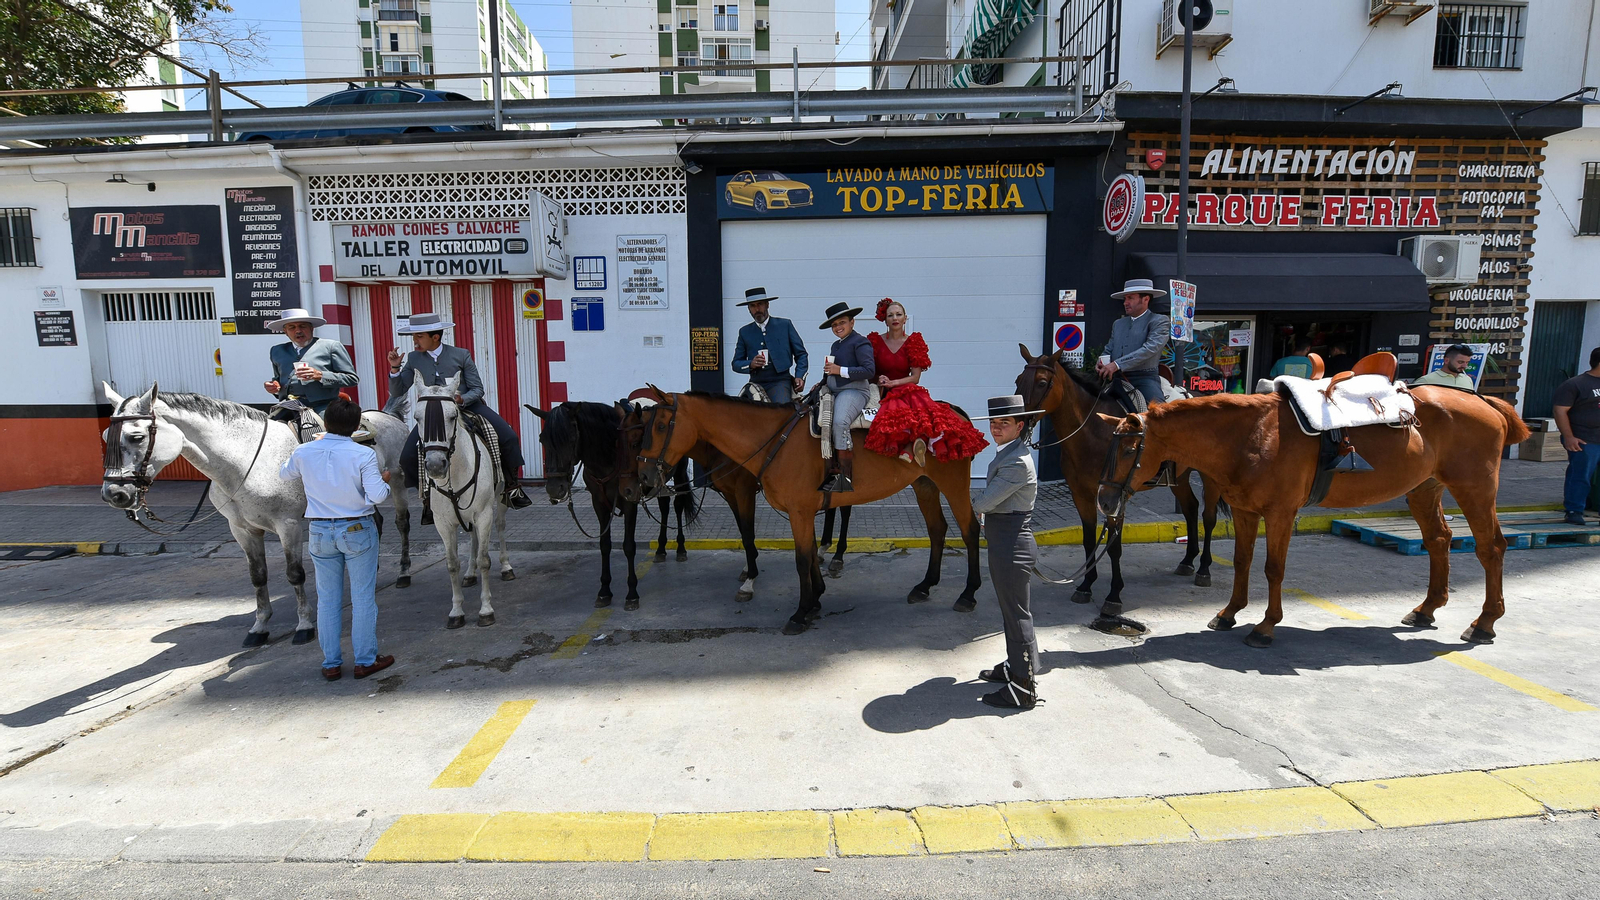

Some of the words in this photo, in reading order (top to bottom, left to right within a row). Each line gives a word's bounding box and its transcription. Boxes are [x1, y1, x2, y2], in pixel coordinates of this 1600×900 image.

[1200, 140, 1416, 178] ALIMENTACIÓN
[826, 167, 883, 183] LAVADO
[886, 168, 896, 181] A
[900, 167, 940, 181] MANO
[944, 166, 962, 180] DE
[964, 161, 1045, 179] VEHÍCULOS
[1458, 164, 1536, 178] CHARCUTERIA
[836, 183, 1024, 212] TOP-FERIA
[1111, 193, 1126, 211] 365
[1462, 191, 1526, 204] FOTOCOPIA
[239, 214, 282, 222] ELECTRICIDAD
[1110, 206, 1124, 218] DIAS
[1116, 180, 1138, 242] SUPERMERCADO
[1140, 192, 1301, 226] PARQUE
[1321, 195, 1441, 228] FERIA
[1480, 205, 1506, 218] FAX
[93, 212, 164, 236] Motos
[245, 224, 277, 232] DIAGNOSIS
[352, 224, 396, 238] RAMON
[402, 222, 450, 236] COINES
[456, 221, 520, 235] CALVACHE
[115, 225, 200, 248] Mancilla
[341, 240, 410, 258] TALLER
[422, 240, 500, 254] ELECTRICIDAD
[362, 264, 386, 277] DEL
[398, 258, 509, 276] AUTOMOVIL
[1454, 316, 1520, 330] BOCADILLOS
